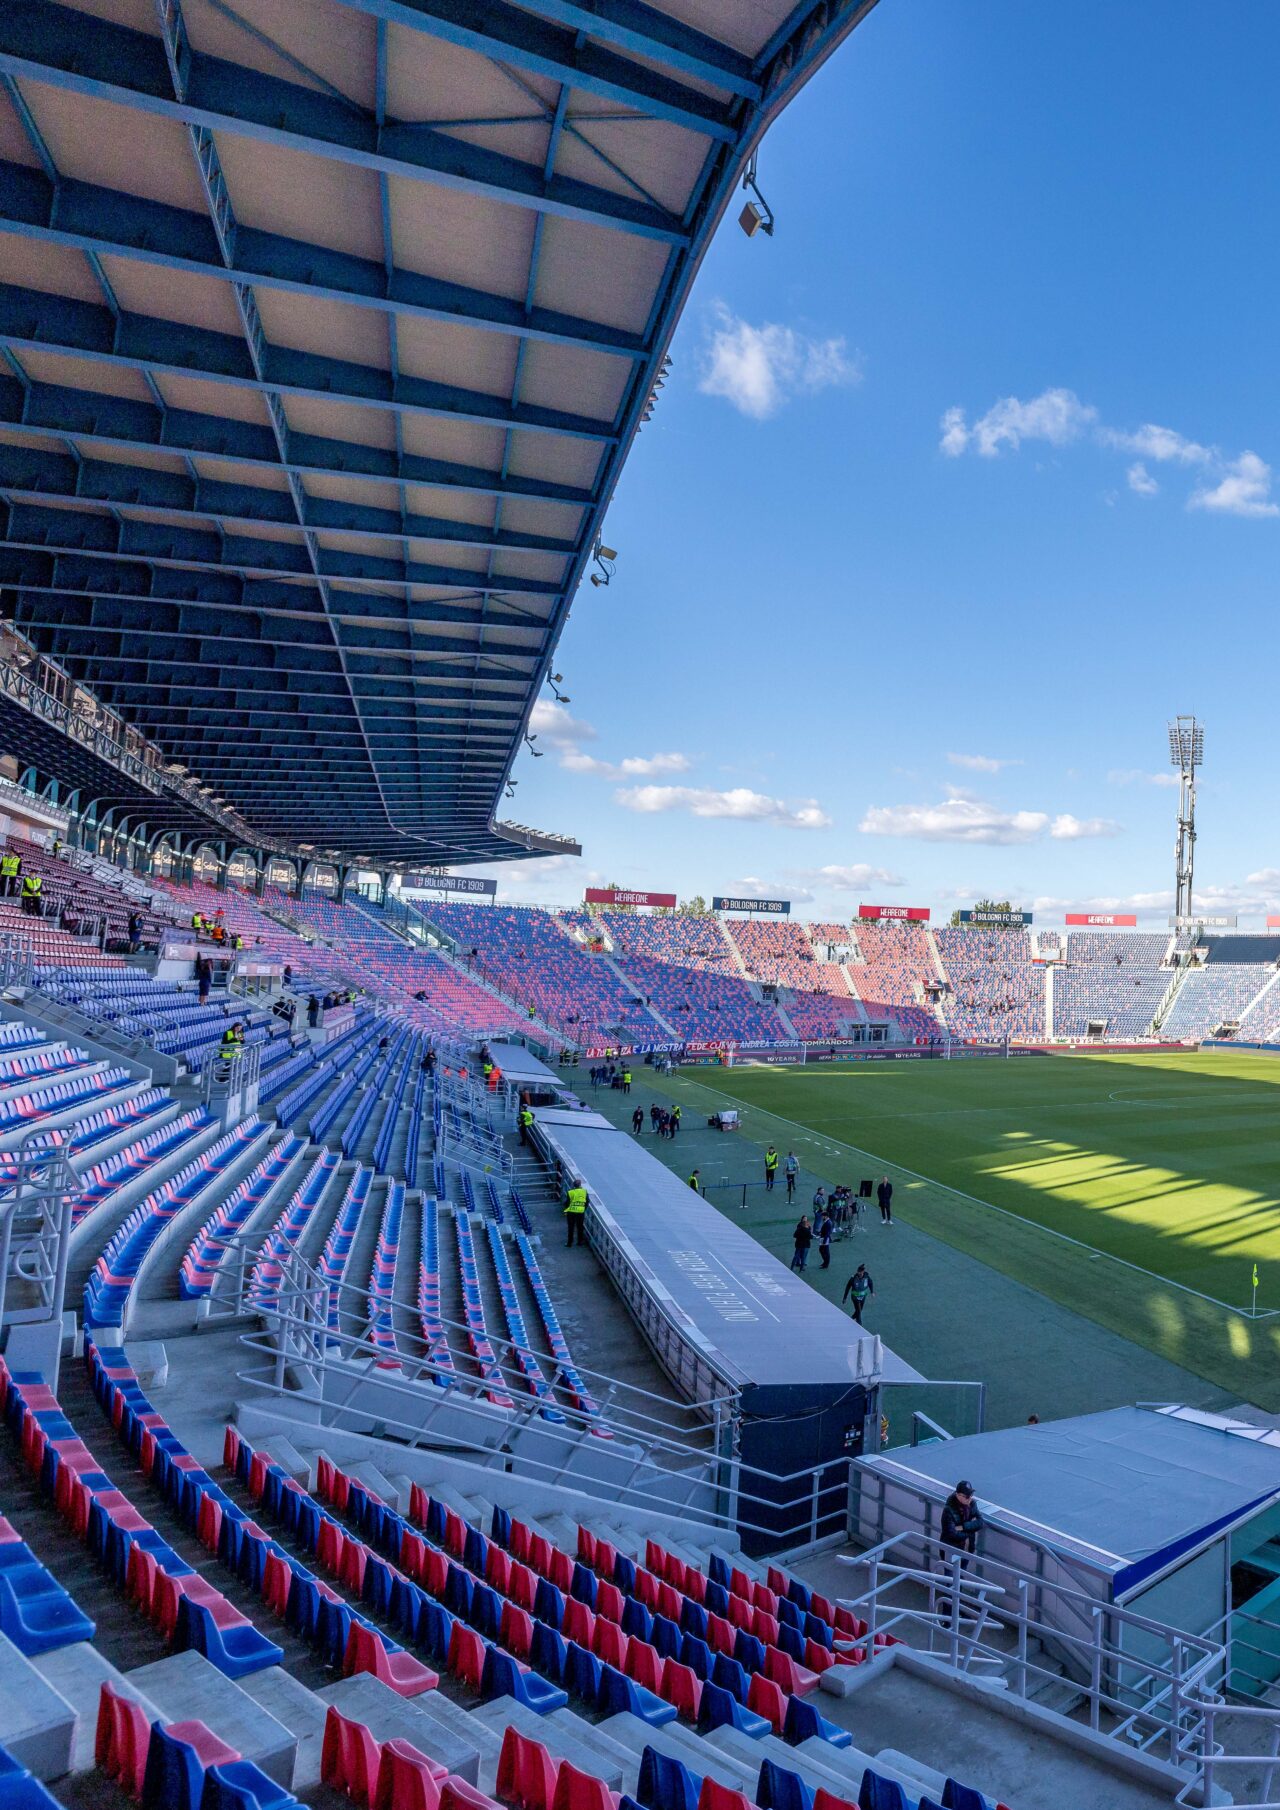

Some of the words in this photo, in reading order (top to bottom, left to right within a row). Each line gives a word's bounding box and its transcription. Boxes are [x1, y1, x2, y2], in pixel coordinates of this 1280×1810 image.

[424, 876, 456, 889] BOLOGNA
[457, 878, 467, 890] FC
[468, 880, 484, 891] 1909
[614, 892, 648, 904] WEAREONE
[730, 900, 758, 910] BOLOGNA
[758, 901, 767, 910] FC
[768, 902, 782, 911] 1909
[880, 908, 909, 918] WEAREONE
[978, 912, 1002, 921] BOLOGNA
[1002, 914, 1010, 922] FC
[1010, 914, 1023, 922] 1909
[640, 1044, 650, 1054] LA
[652, 1043, 684, 1053] NOSTRA
[686, 1042, 709, 1050] FEDE
[739, 1040, 770, 1049] ANDREA
[774, 1040, 799, 1048] COSTA
[702, 1292, 760, 1322] PLATINO
